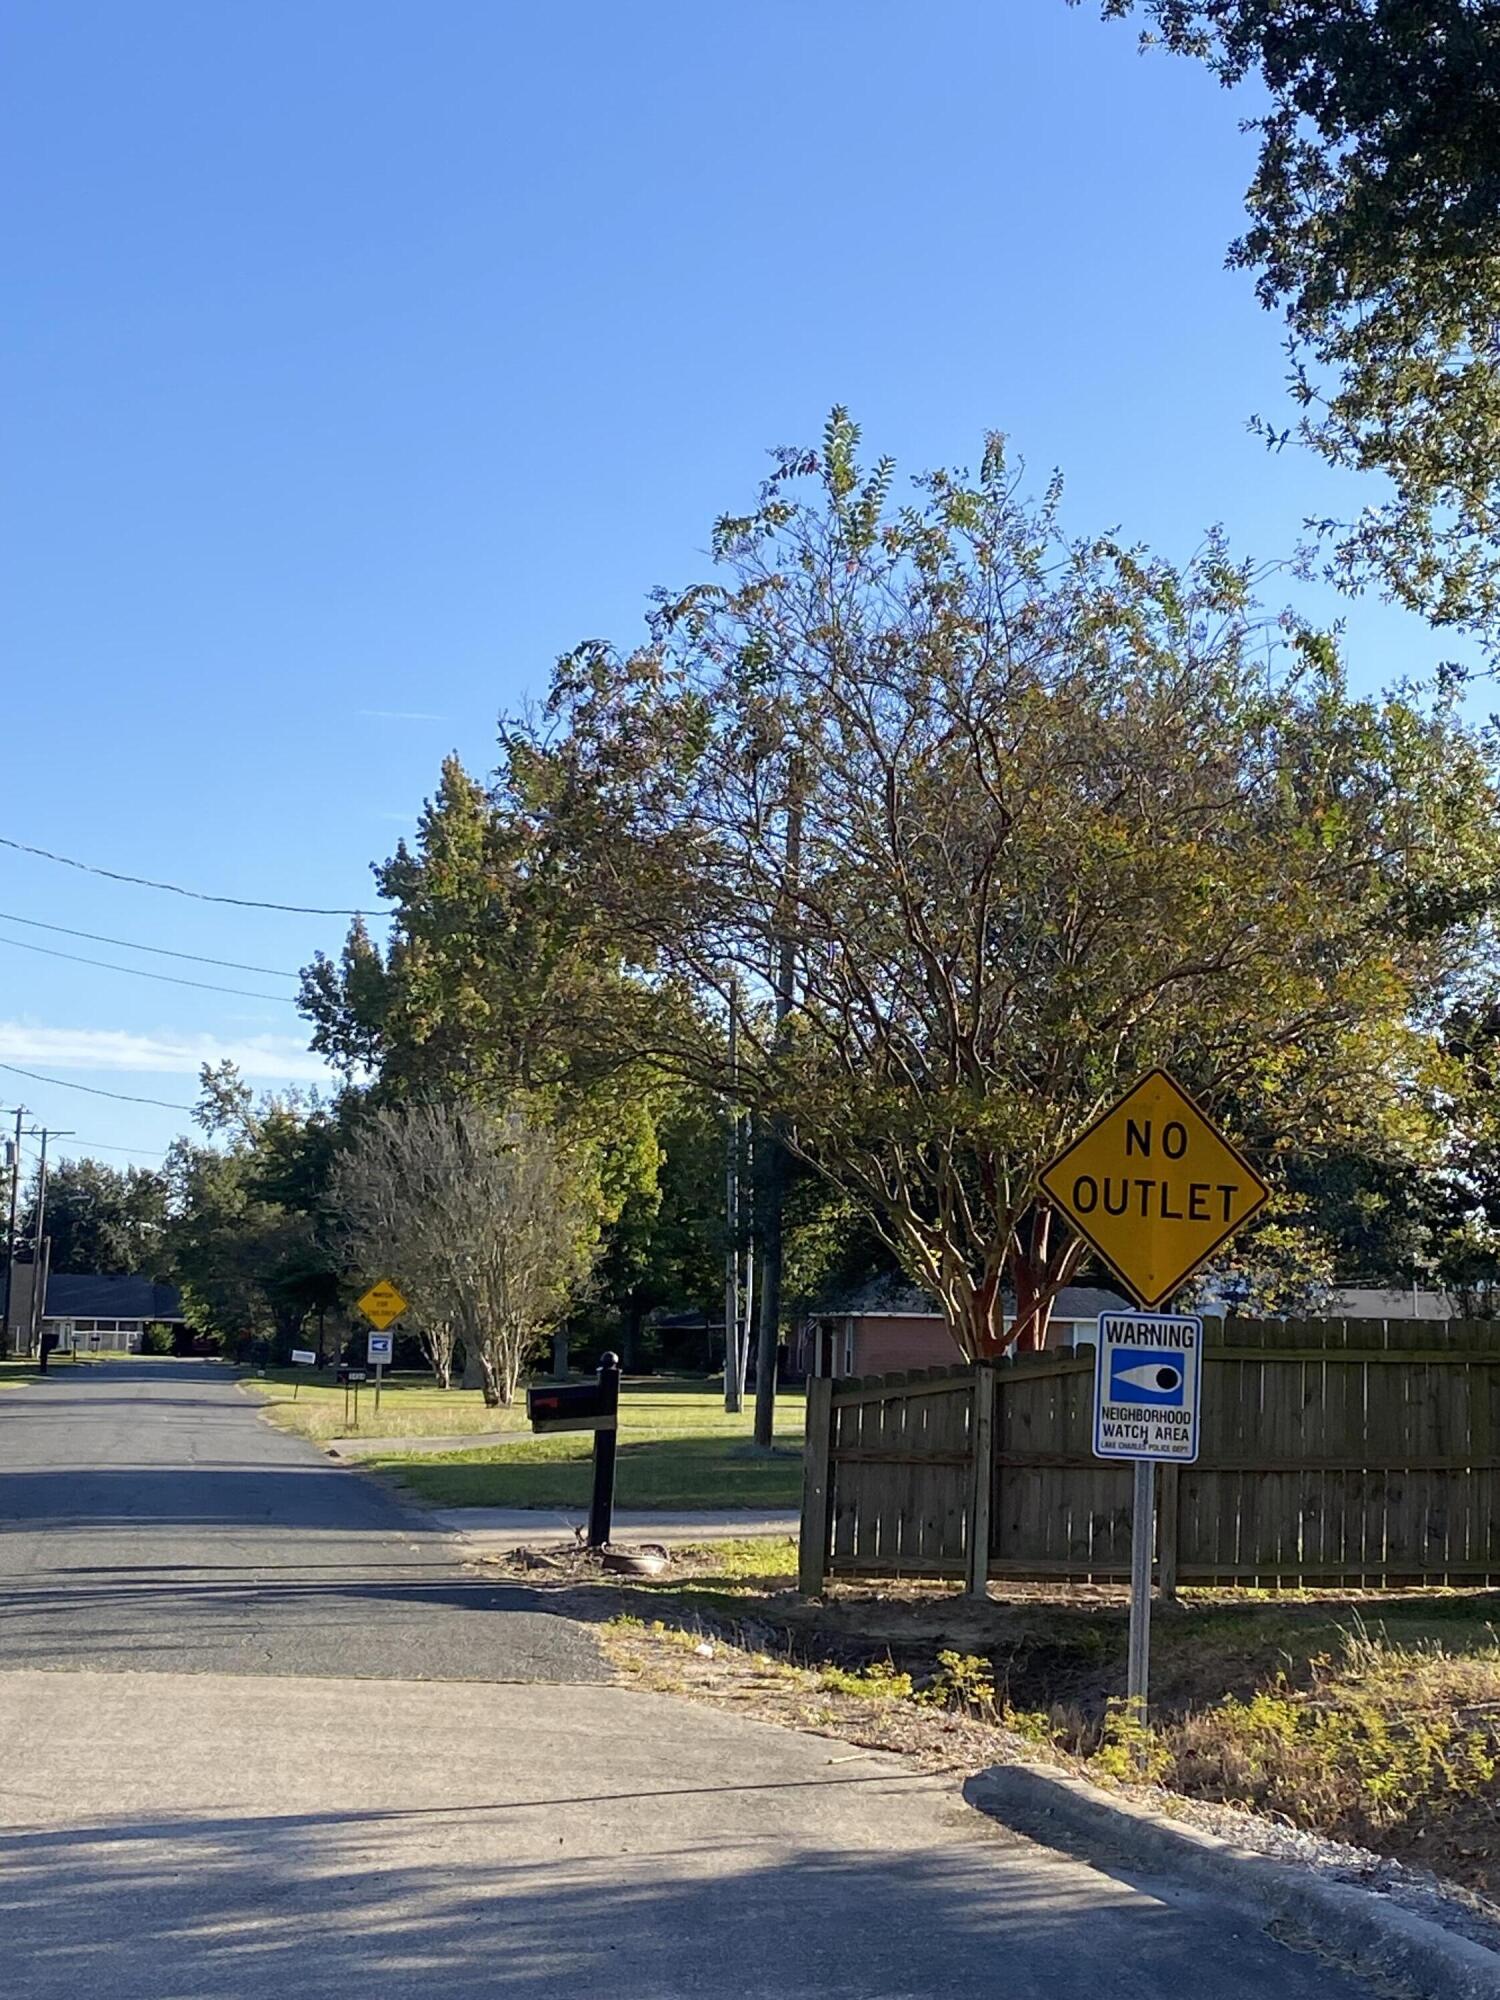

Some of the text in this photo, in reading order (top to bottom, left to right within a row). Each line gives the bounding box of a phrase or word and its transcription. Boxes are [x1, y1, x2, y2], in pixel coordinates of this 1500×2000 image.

[1125, 1119, 1188, 1160] NO
[1072, 1175, 1239, 1222] OUTLET
[1106, 1320, 1194, 1348] WARNING
[1102, 1406, 1191, 1424] NEIGHBORHOOD
[1103, 1423, 1190, 1441] WATCH AREA
[1101, 1440, 1116, 1450] LAKE
[1148, 1443, 1170, 1452] POLICE
